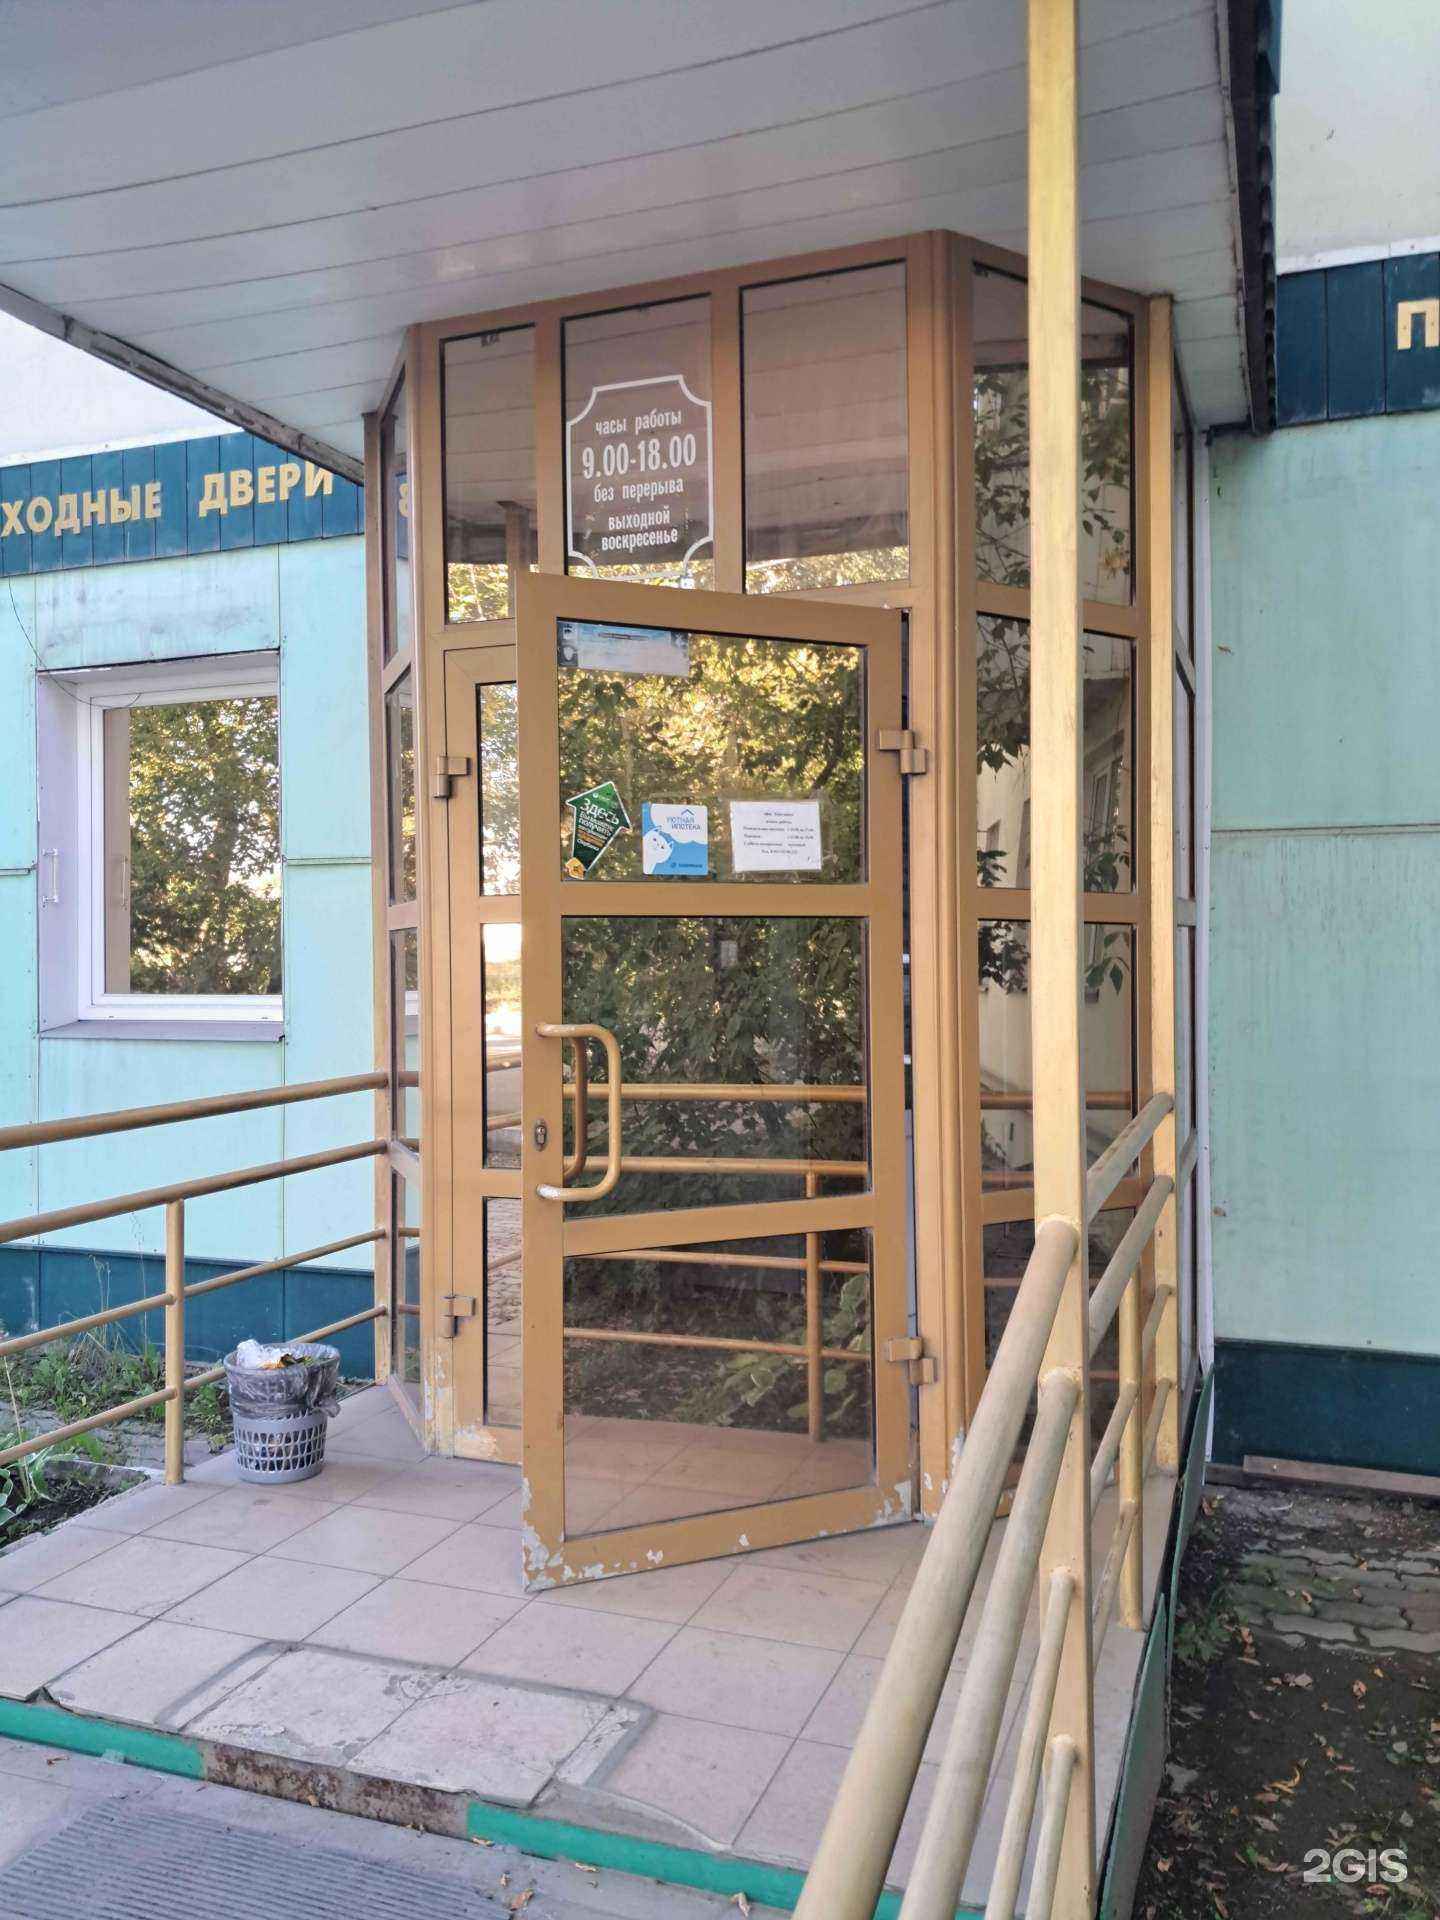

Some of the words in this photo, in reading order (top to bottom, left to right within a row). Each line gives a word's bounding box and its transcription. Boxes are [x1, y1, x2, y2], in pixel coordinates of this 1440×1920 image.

[1397, 298, 1440, 350] П
[595, 417, 626, 436] часы
[635, 408, 682, 435] работы
[582, 433, 697, 480] 9.00-18.00
[0, 481, 162, 538] ХОДНЫЕ
[199, 461, 333, 518] ДВЕРИ
[594, 483, 615, 502] без
[622, 478, 684, 501] перерыва
[608, 506, 671, 531] выходной
[601, 527, 678, 553] воскресенье
